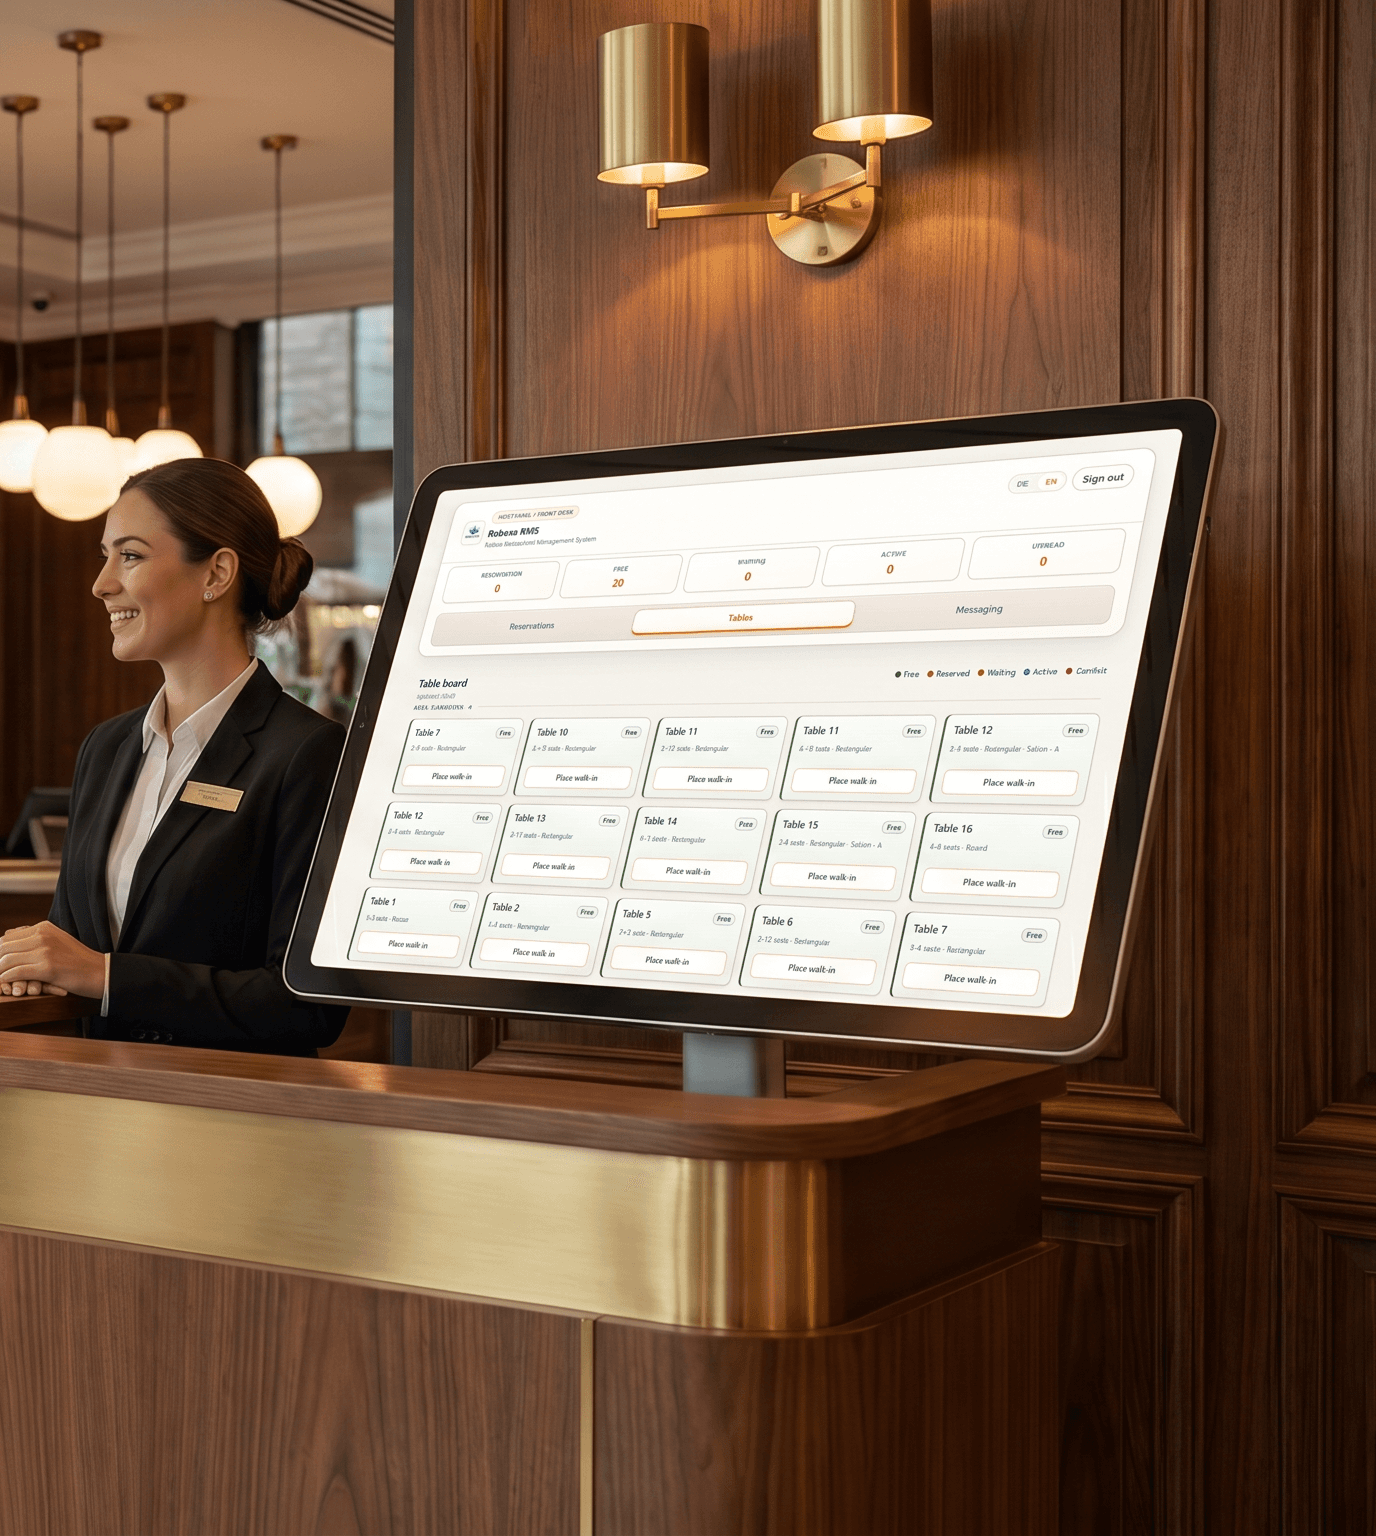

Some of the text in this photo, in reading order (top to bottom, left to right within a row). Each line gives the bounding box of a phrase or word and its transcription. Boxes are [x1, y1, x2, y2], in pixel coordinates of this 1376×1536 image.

[1045, 477, 1058, 486] EN
[1082, 472, 1125, 485] Sign out
[487, 529, 518, 538] Robexa
[1039, 556, 1047, 567] 0
[886, 564, 894, 574] 0
[744, 571, 752, 582] 0
[612, 578, 624, 588] 20
[494, 584, 500, 593] 0
[955, 605, 1003, 615] Messaging
[728, 613, 754, 623] Tables
[509, 621, 555, 632] Reservations
[903, 670, 920, 678] Free
[936, 669, 971, 678] Reserved
[987, 669, 1016, 678] Waiting
[419, 678, 469, 688] Table board
[415, 729, 434, 737] Table
[537, 728, 569, 737] Table 10
[665, 727, 698, 736] Table 11
[803, 726, 839, 735] Table 11
[954, 725, 993, 735] Table 12
[556, 774, 572, 782] Place
[828, 777, 848, 785] Place
[983, 778, 1035, 787] Place walk-in
[393, 811, 423, 820] Table 12
[514, 814, 546, 823] Table 13
[644, 817, 677, 825] Table 14
[783, 820, 819, 829] Table 15
[933, 823, 973, 833] Table 16
[410, 858, 426, 866] Place
[532, 862, 550, 870] Place
[665, 867, 684, 875] Place
[808, 872, 857, 882] Place walk-in
[963, 878, 1017, 889] Place walk-in
[370, 897, 396, 906] Table 1
[492, 903, 519, 912] Table 2
[622, 910, 651, 918] Table 5
[762, 916, 793, 926] Table 6
[864, 923, 881, 931] Free
[913, 924, 948, 935] Table 7
[1025, 931, 1043, 939] Free
[388, 940, 404, 948] Place
[513, 948, 530, 957] Place
[645, 956, 663, 964] Place
[788, 964, 807, 973] Place
[944, 974, 965, 984] Place
